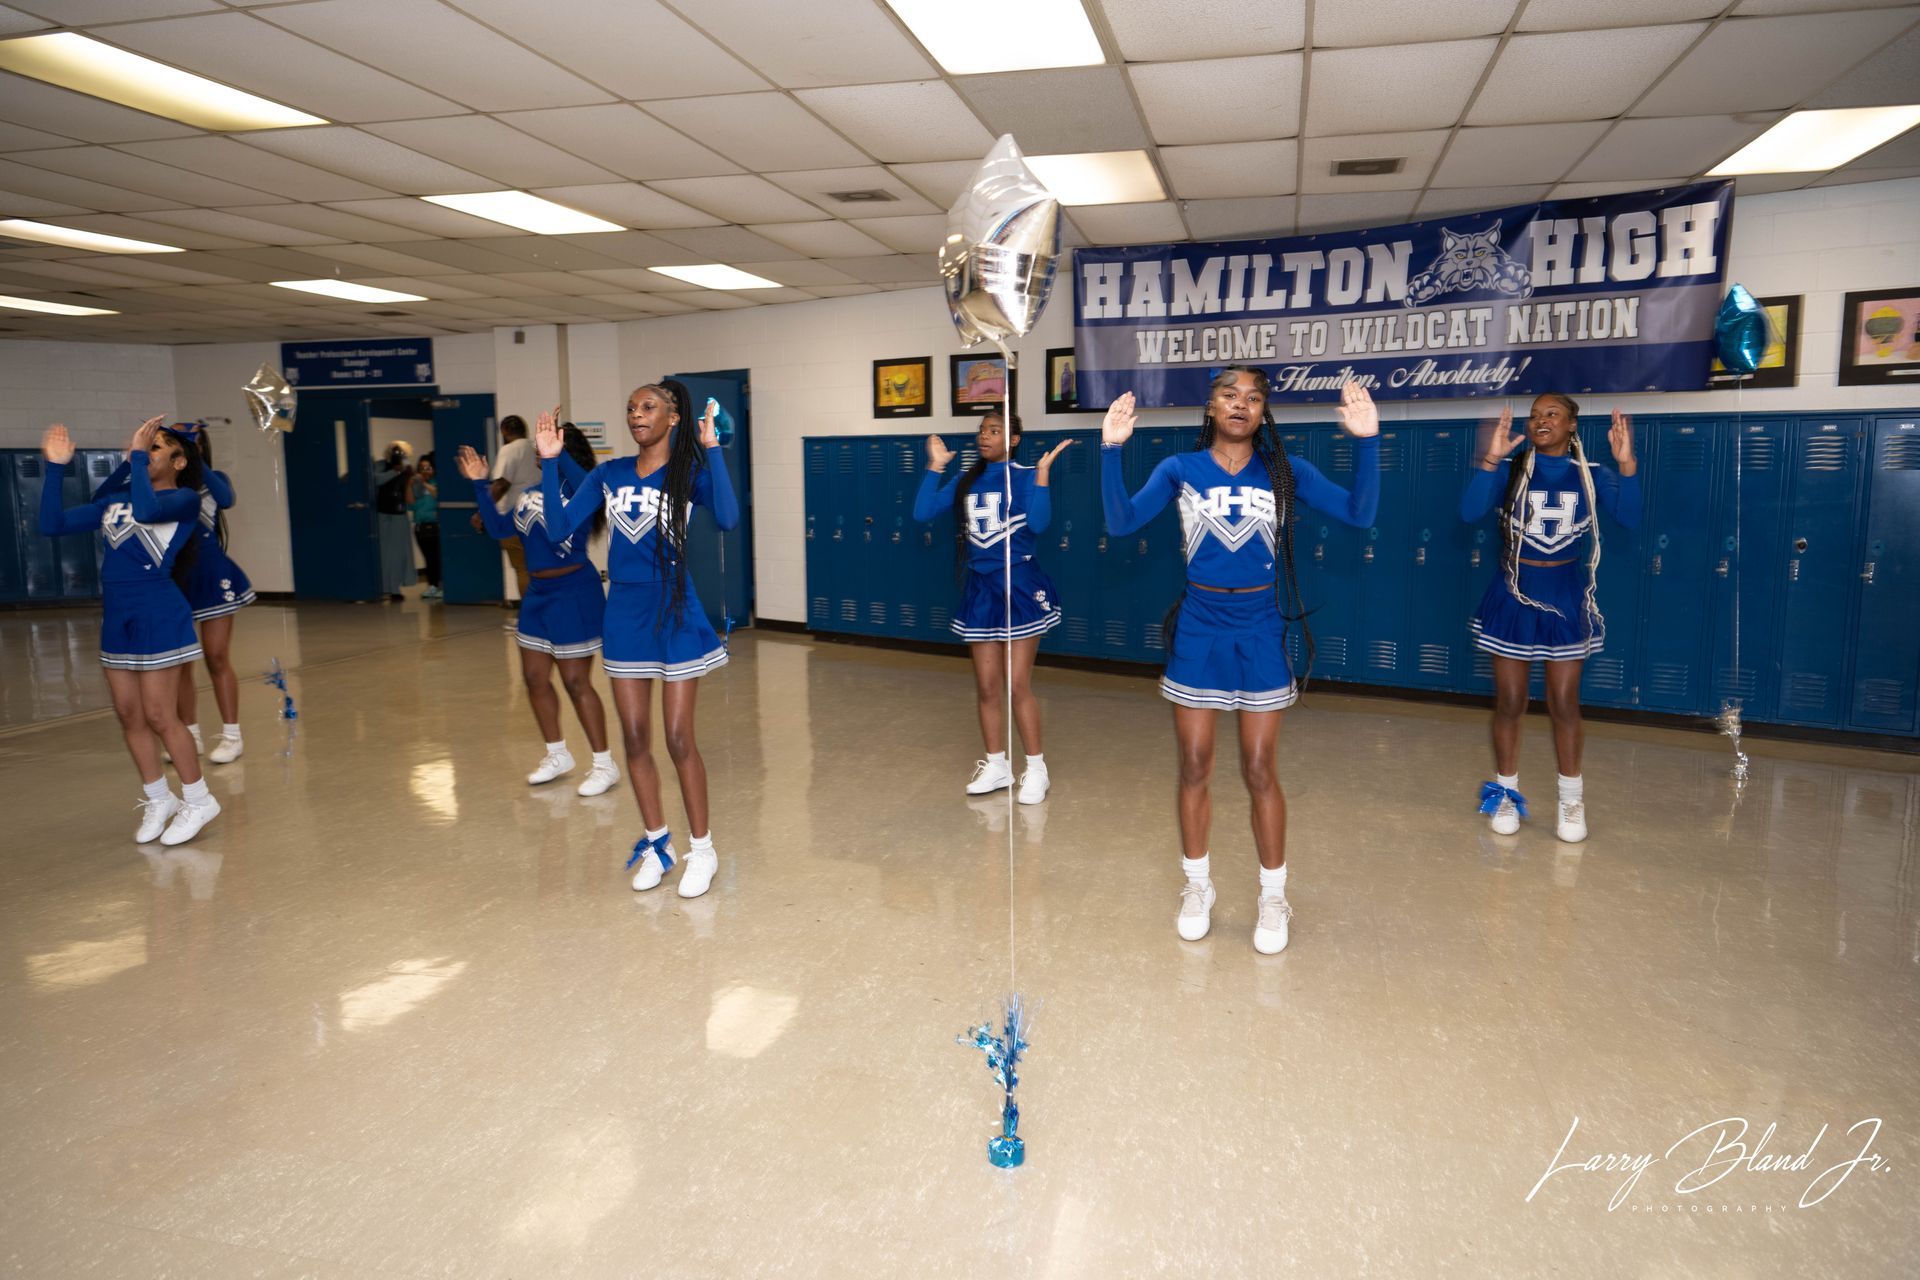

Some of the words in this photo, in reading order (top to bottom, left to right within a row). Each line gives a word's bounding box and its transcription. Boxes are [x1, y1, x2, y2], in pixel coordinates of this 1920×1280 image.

[1082, 240, 1413, 319] HAMILTON
[1528, 200, 1720, 288] HIGH
[1136, 323, 1278, 364] WELCOME
[1290, 320, 1328, 357] TO
[1341, 307, 1493, 354] WILDCAT
[1506, 297, 1640, 345] NATION
[1391, 356, 1533, 391] Absolutely!
[964, 492, 1003, 533] H
[1525, 490, 1579, 536] H
